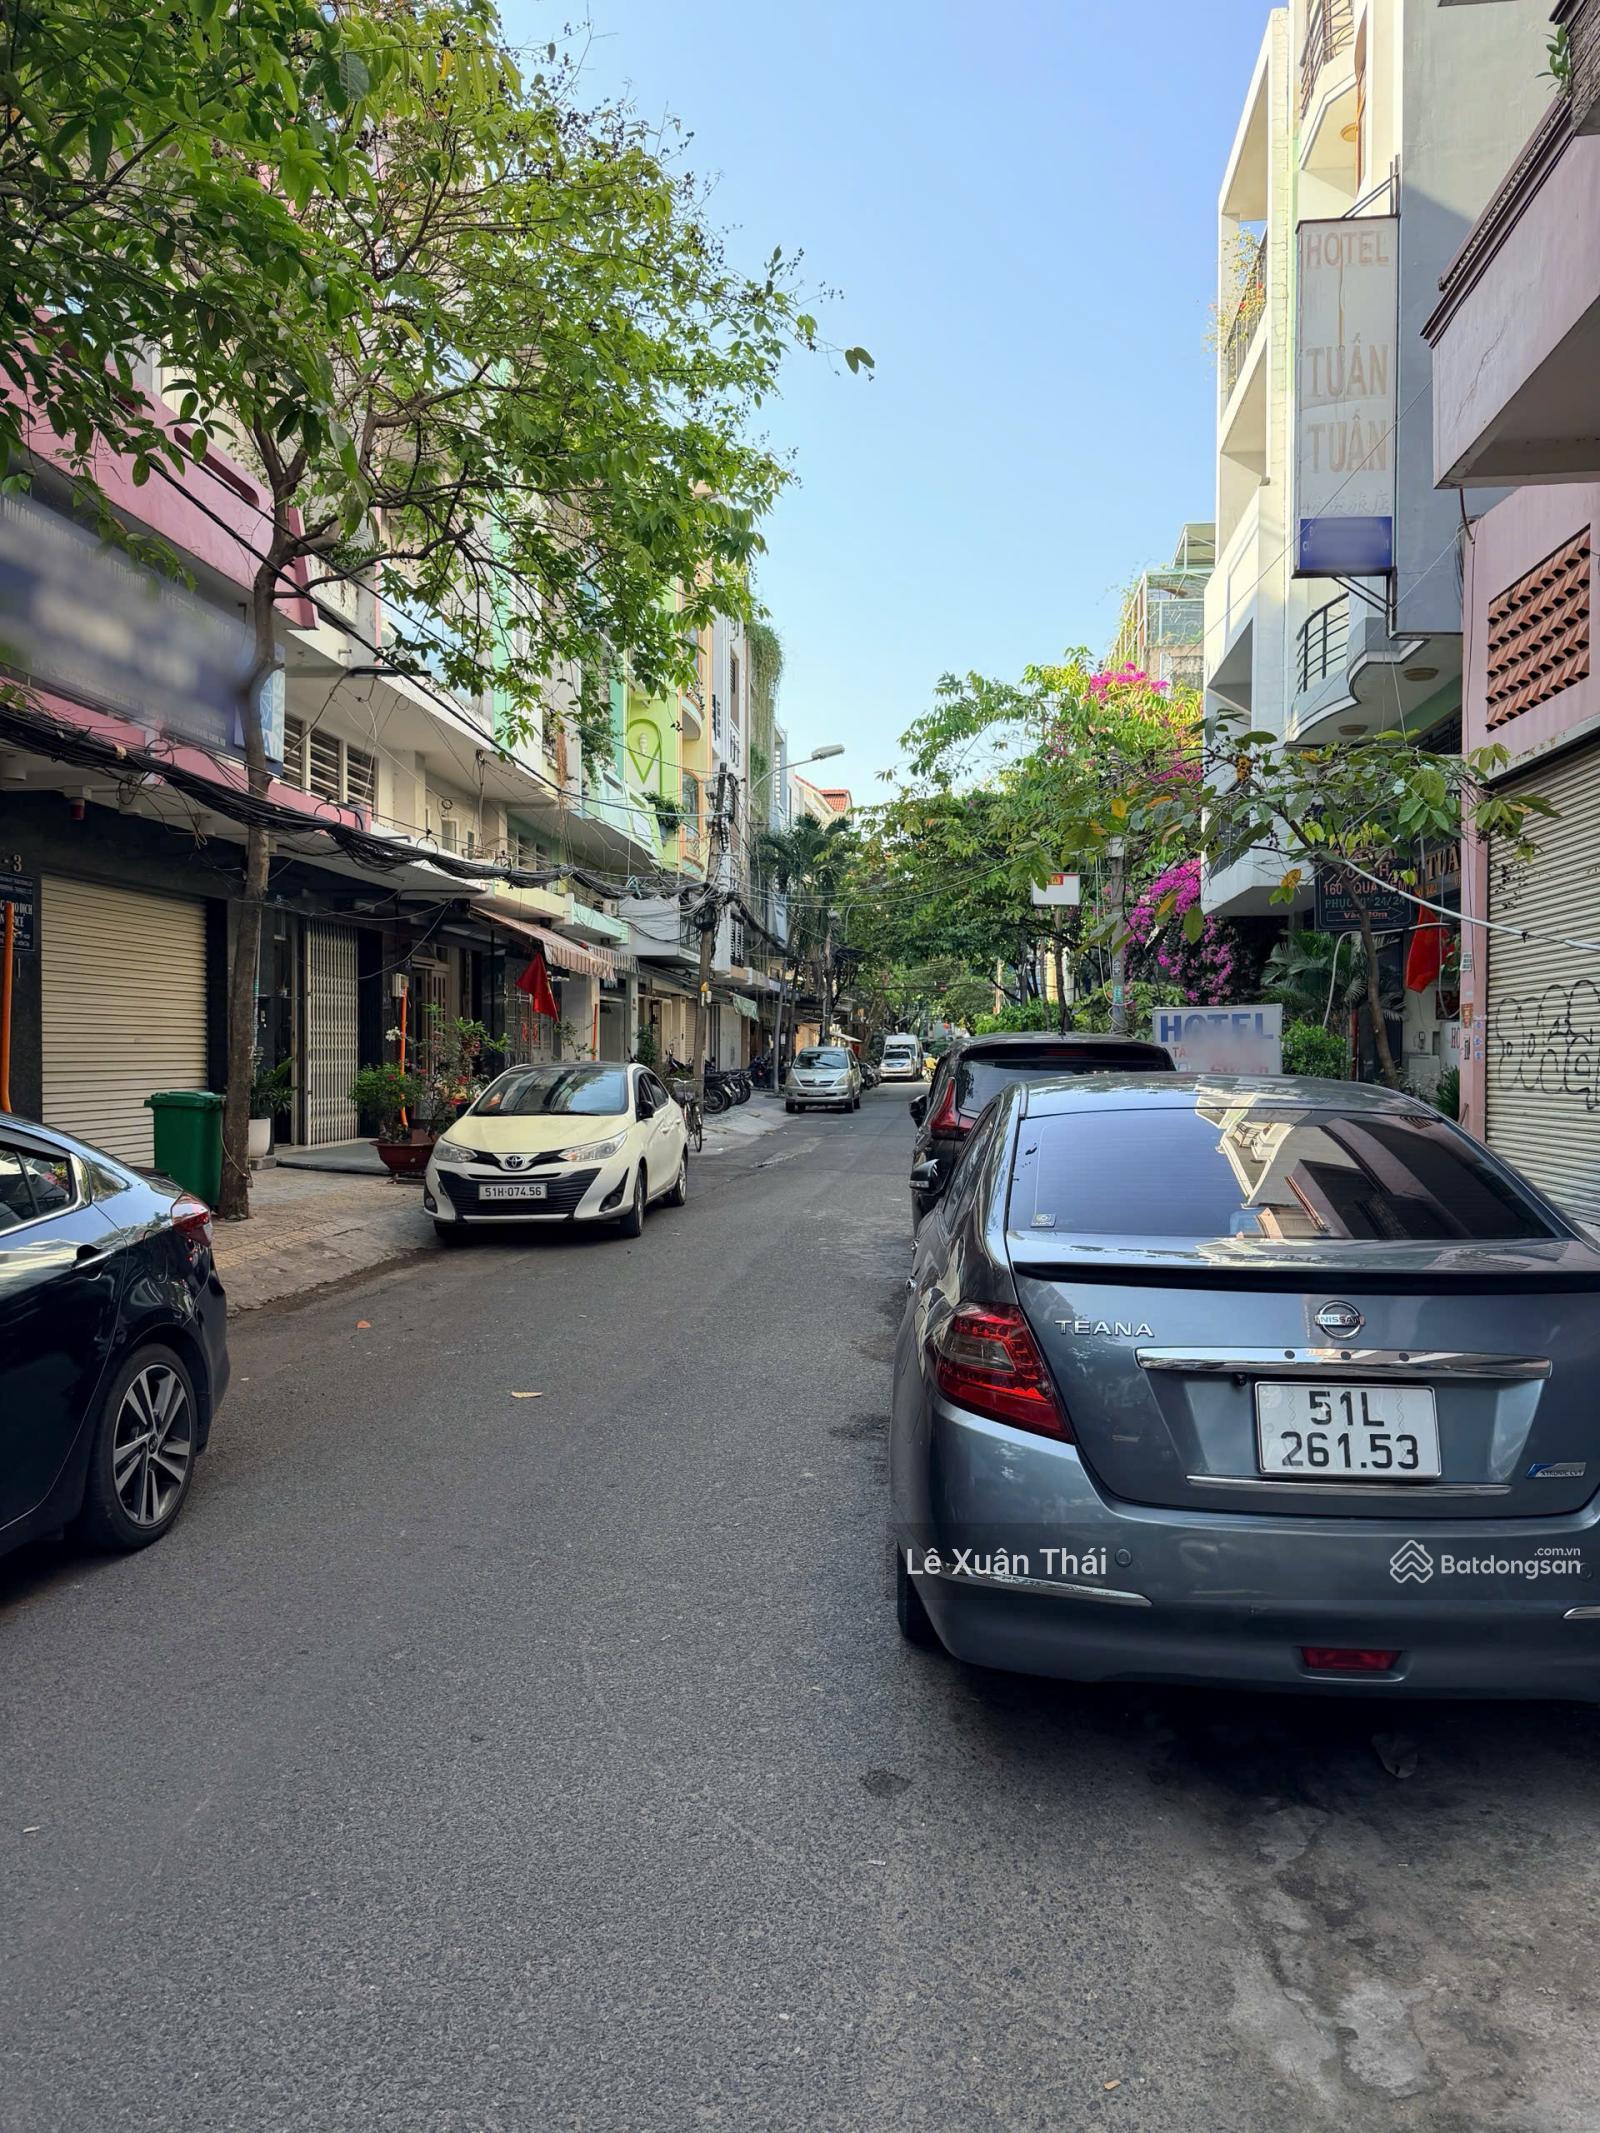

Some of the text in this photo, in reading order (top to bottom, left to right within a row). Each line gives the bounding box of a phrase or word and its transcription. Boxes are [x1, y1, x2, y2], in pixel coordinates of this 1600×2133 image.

[1307, 230, 1389, 270] HOTEL
[1160, 1012, 1275, 1042] HOTEL
[1054, 1320, 1155, 1338] TEANA
[1320, 1314, 1360, 1325] NISSAN
[1309, 1390, 1385, 1427] 51L
[1280, 1431, 1420, 1470] 261.53
